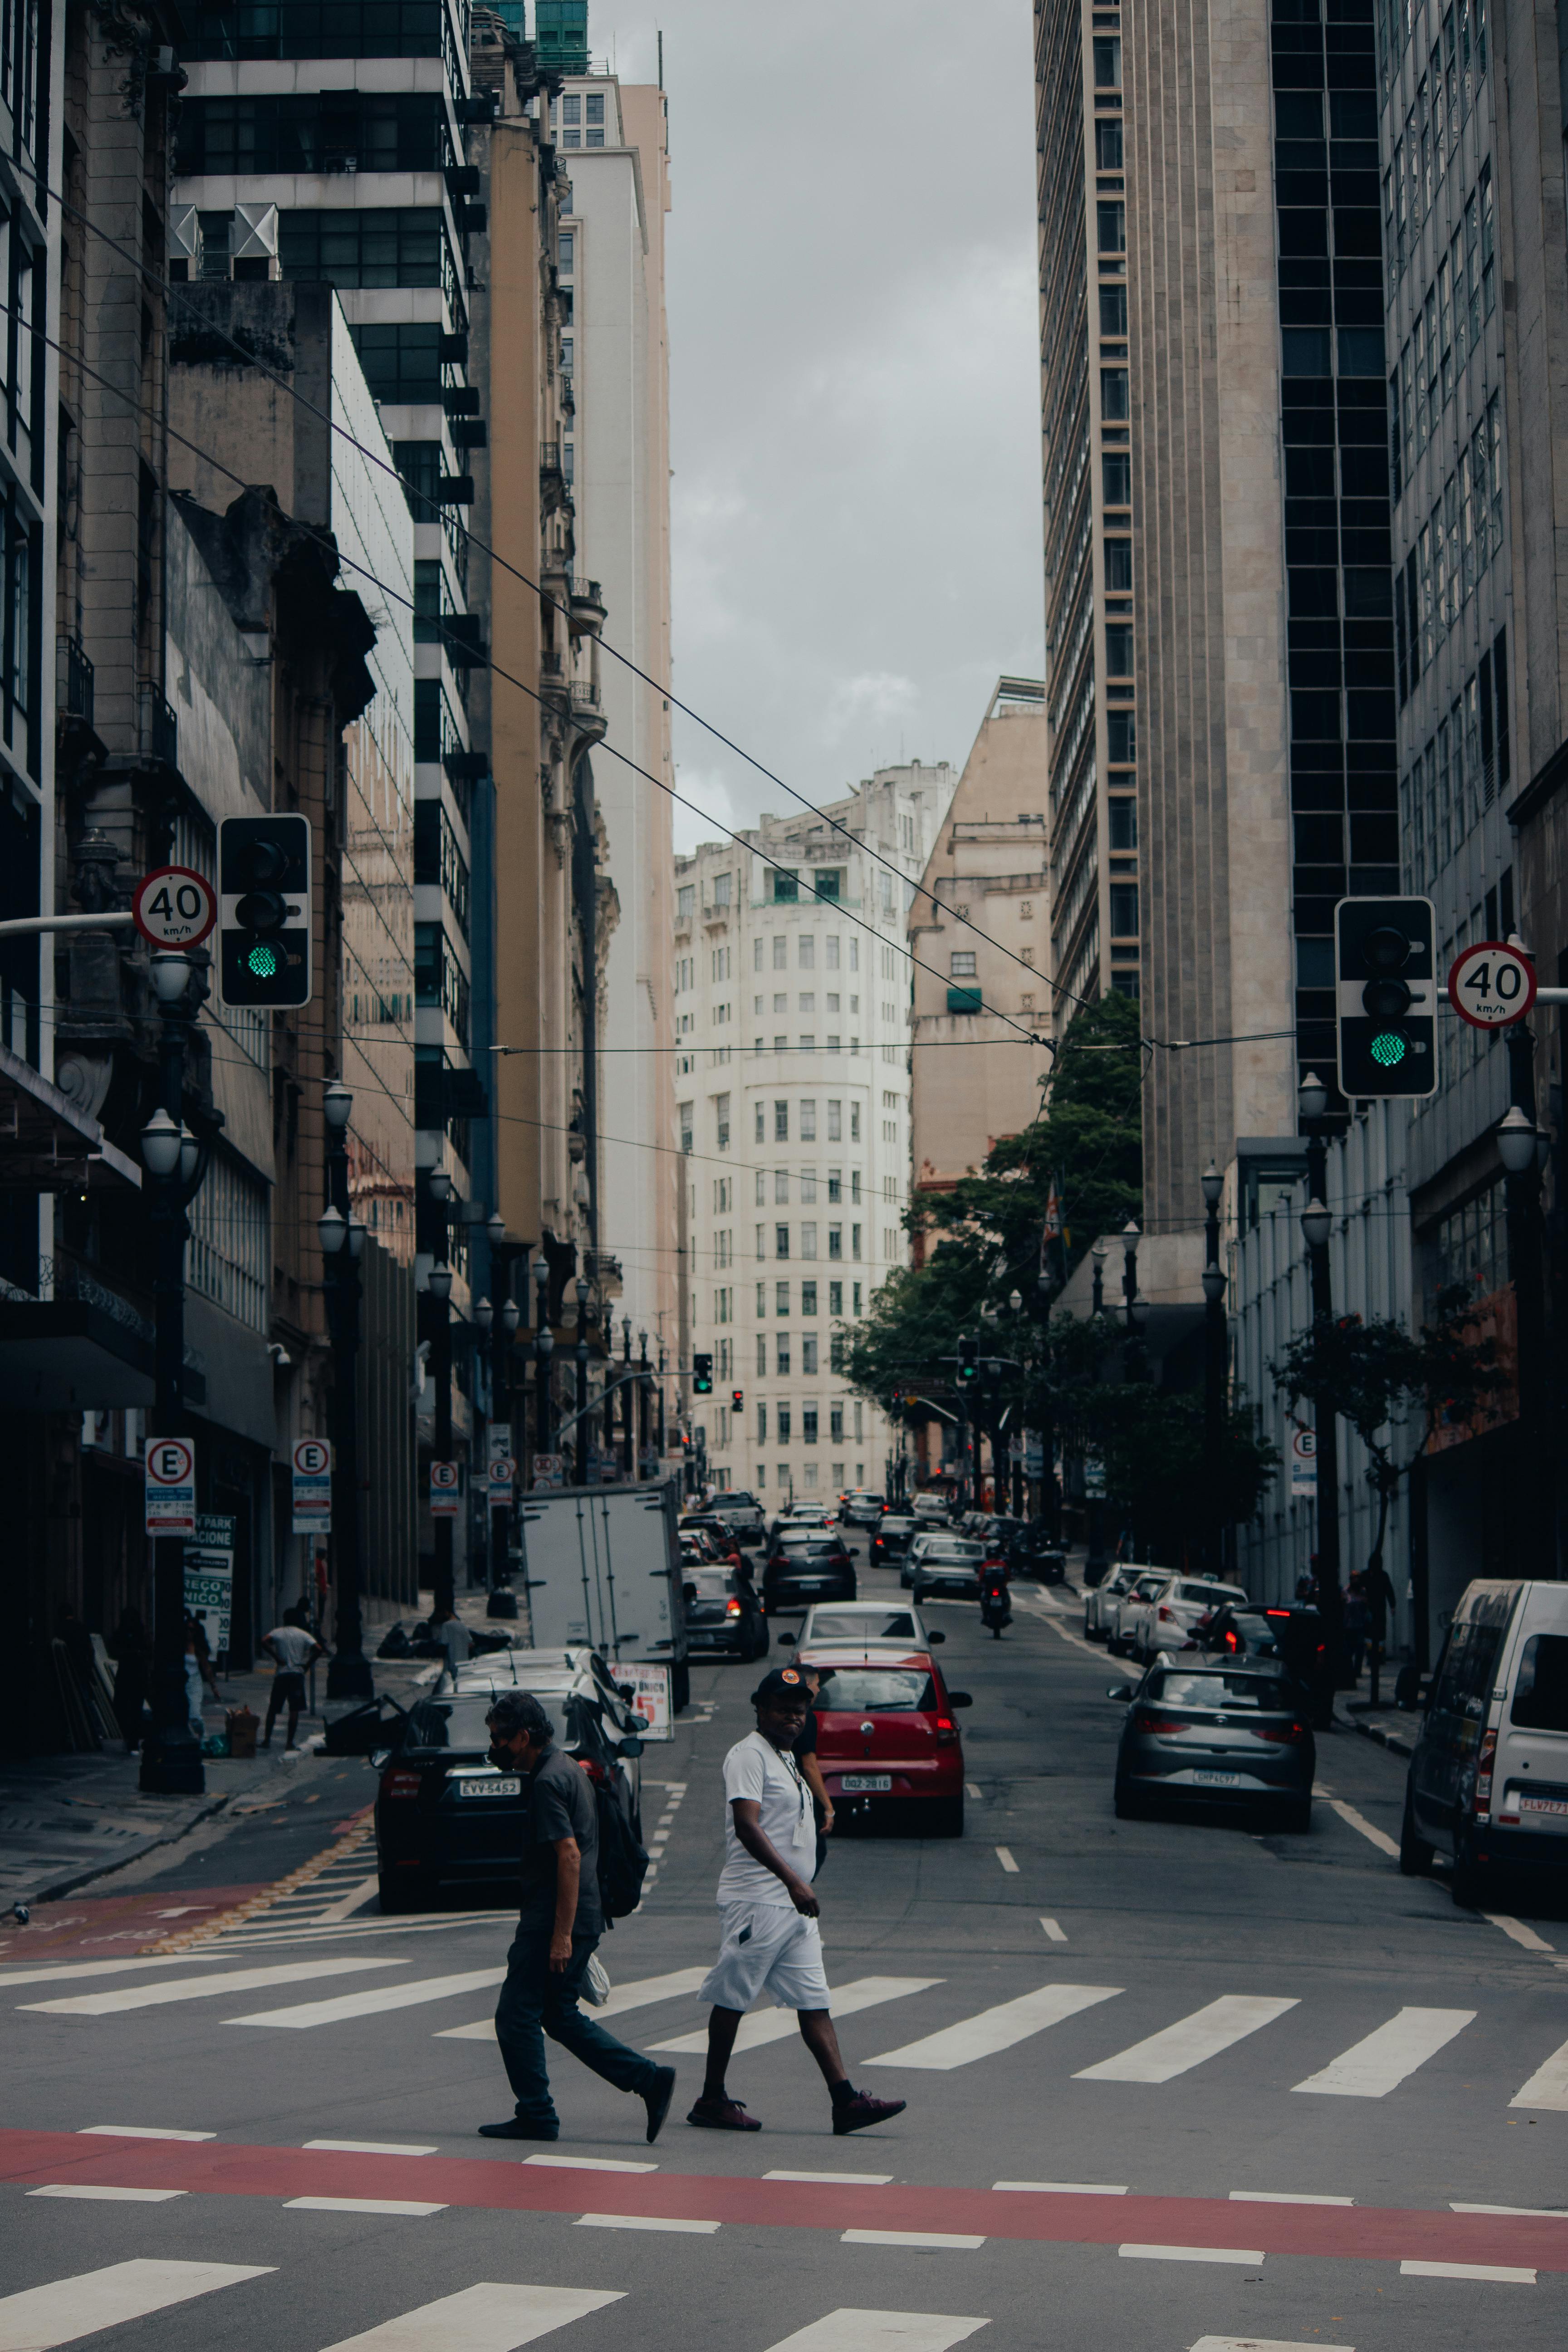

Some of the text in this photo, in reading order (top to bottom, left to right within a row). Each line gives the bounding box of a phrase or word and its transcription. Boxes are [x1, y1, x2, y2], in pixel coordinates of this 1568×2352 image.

[148, 884, 201, 921] 40
[163, 926, 191, 936] km/h
[1465, 962, 1521, 1000] 40
[1476, 1004, 1506, 1014] km/h
[1302, 1435, 1312, 1451] E
[162, 1450, 178, 1475] E
[306, 1448, 318, 1467] E
[440, 1468, 449, 1483] E
[496, 1465, 504, 1478] E
[204, 1517, 232, 1530] PARK
[639, 1680, 664, 1693] ÚNICO
